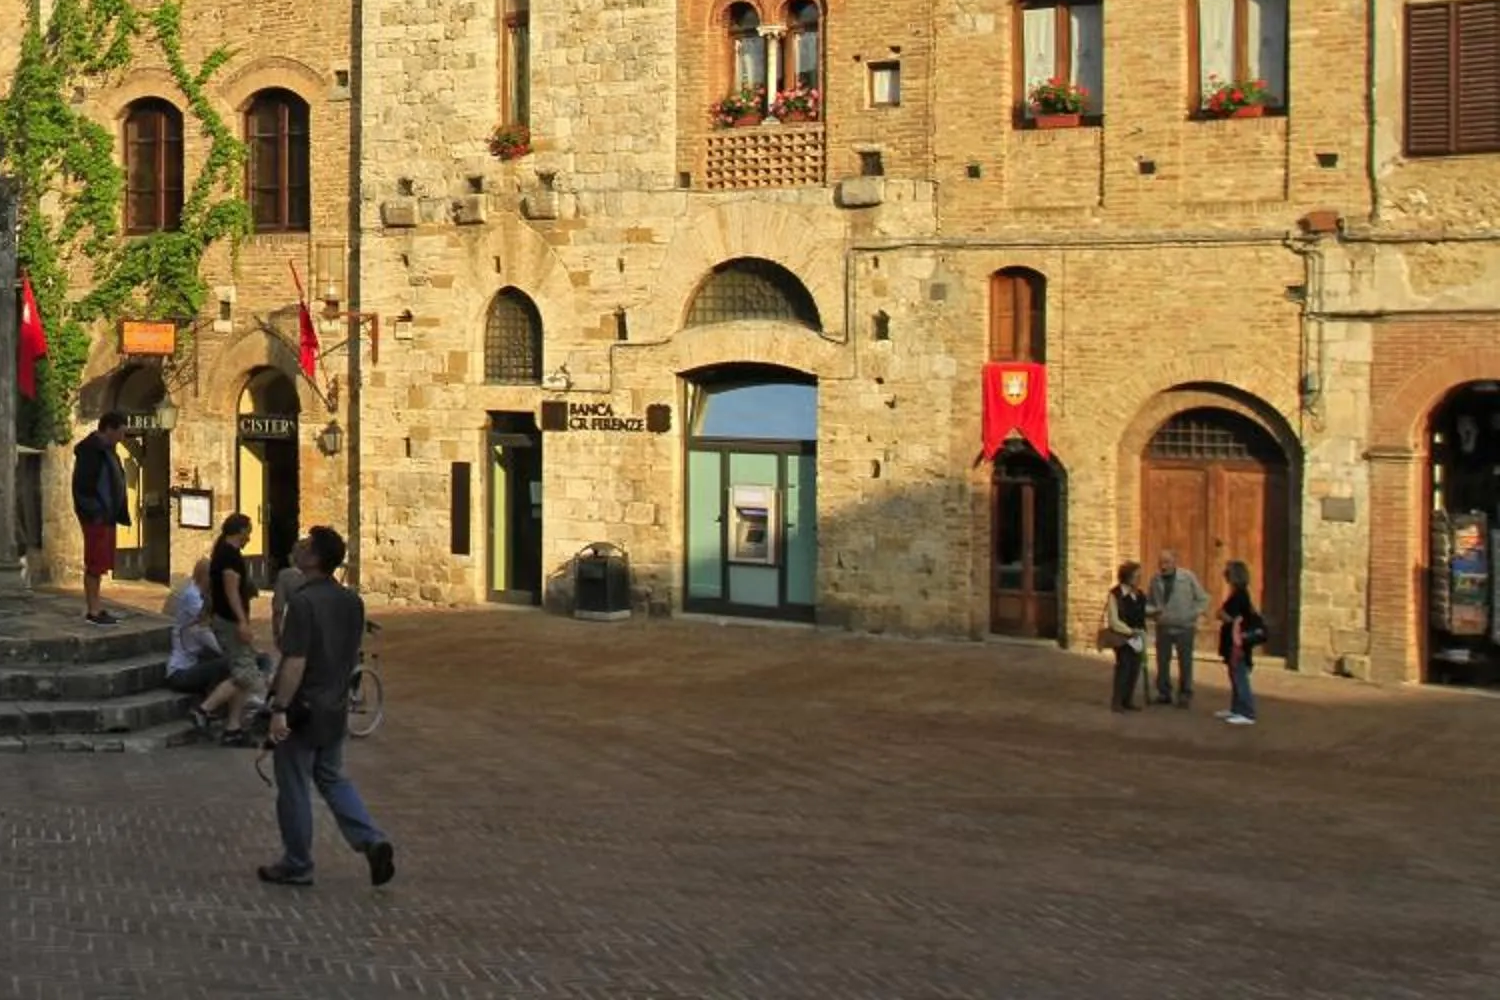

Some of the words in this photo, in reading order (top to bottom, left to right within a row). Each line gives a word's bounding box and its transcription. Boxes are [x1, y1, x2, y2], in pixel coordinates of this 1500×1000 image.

[569, 402, 613, 416] BANCA
[569, 417, 588, 431] CR
[591, 418, 644, 432] FIRENZE
